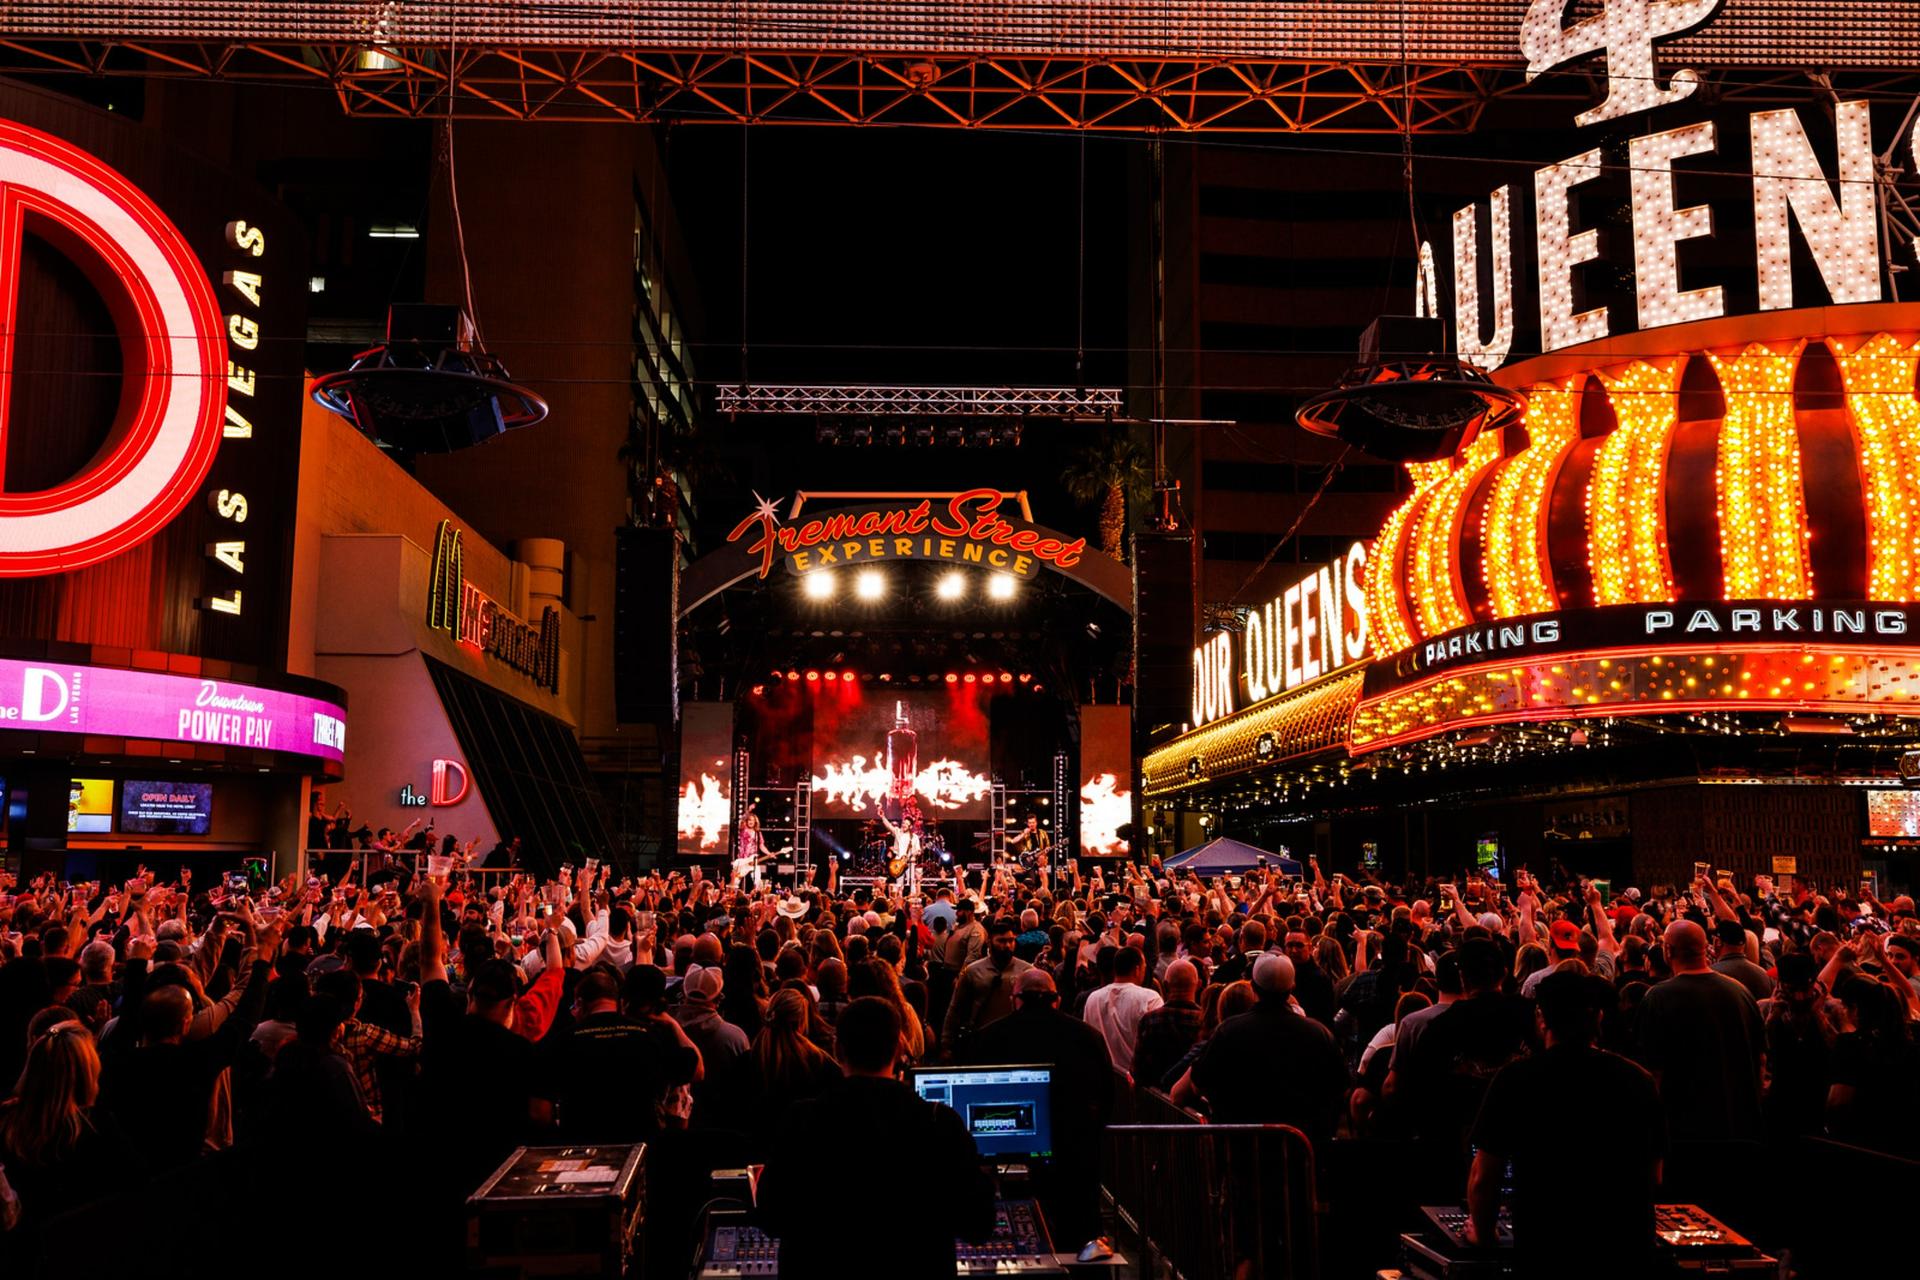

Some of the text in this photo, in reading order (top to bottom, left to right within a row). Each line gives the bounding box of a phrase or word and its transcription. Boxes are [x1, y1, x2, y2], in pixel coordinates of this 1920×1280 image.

[1416, 100, 1920, 374] UEEN
[211, 220, 265, 615] LAS VEGAS
[726, 488, 1086, 579] Fremont Street
[793, 538, 1032, 575] EXPERIENCE
[1188, 541, 1367, 728] OUR QUEENS
[1425, 620, 1560, 666] PARKING
[1645, 608, 1907, 634] PARKING
[22, 667, 69, 722] D
[196, 680, 264, 713] Downtown
[178, 708, 272, 747] POWER PAY
[141, 793, 196, 803] OPEN DAILY
[401, 759, 468, 808] the D
